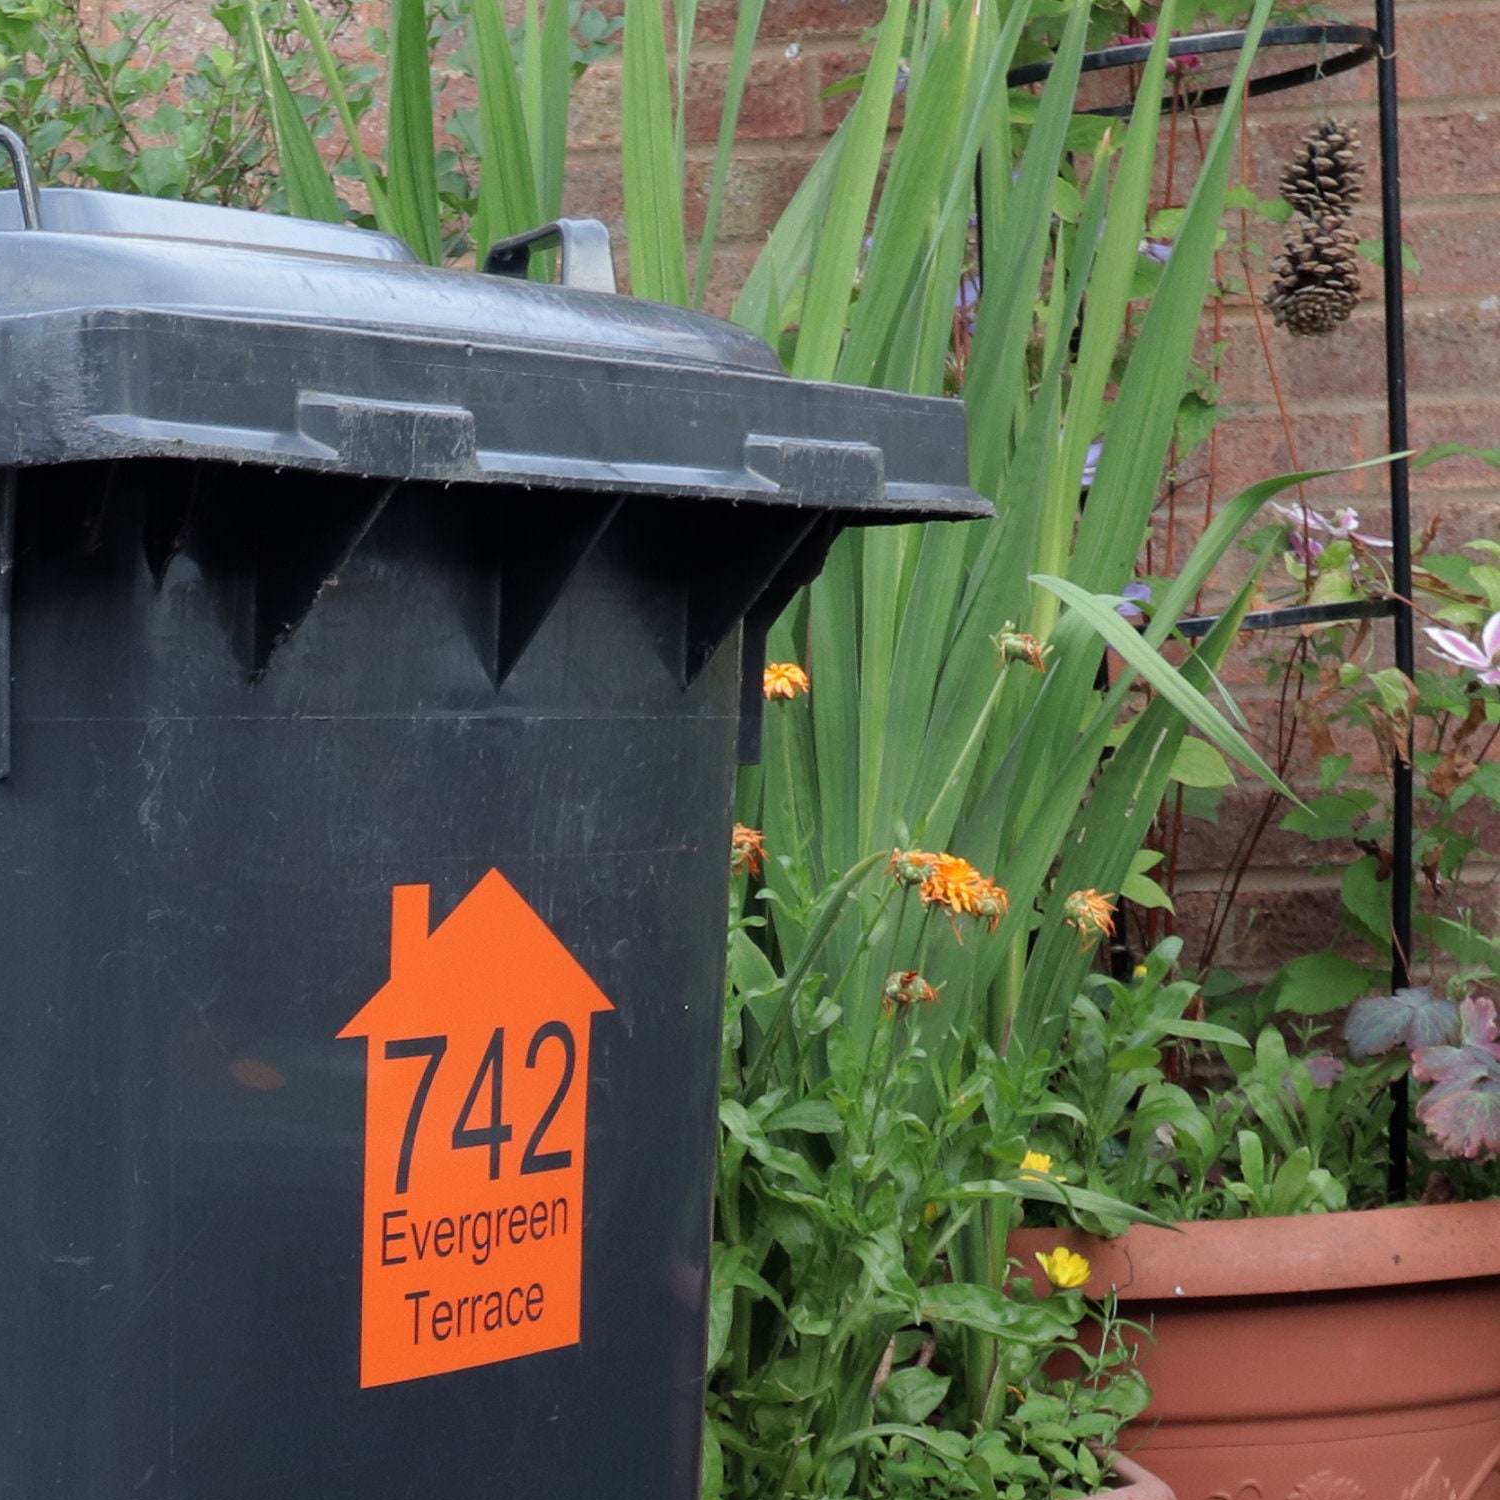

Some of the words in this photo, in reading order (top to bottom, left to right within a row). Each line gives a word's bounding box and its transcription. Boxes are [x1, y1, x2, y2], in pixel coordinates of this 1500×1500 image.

[384, 1020, 577, 1195] 742
[381, 1197, 568, 1267] Evergreen
[404, 1282, 544, 1344] Terrace
